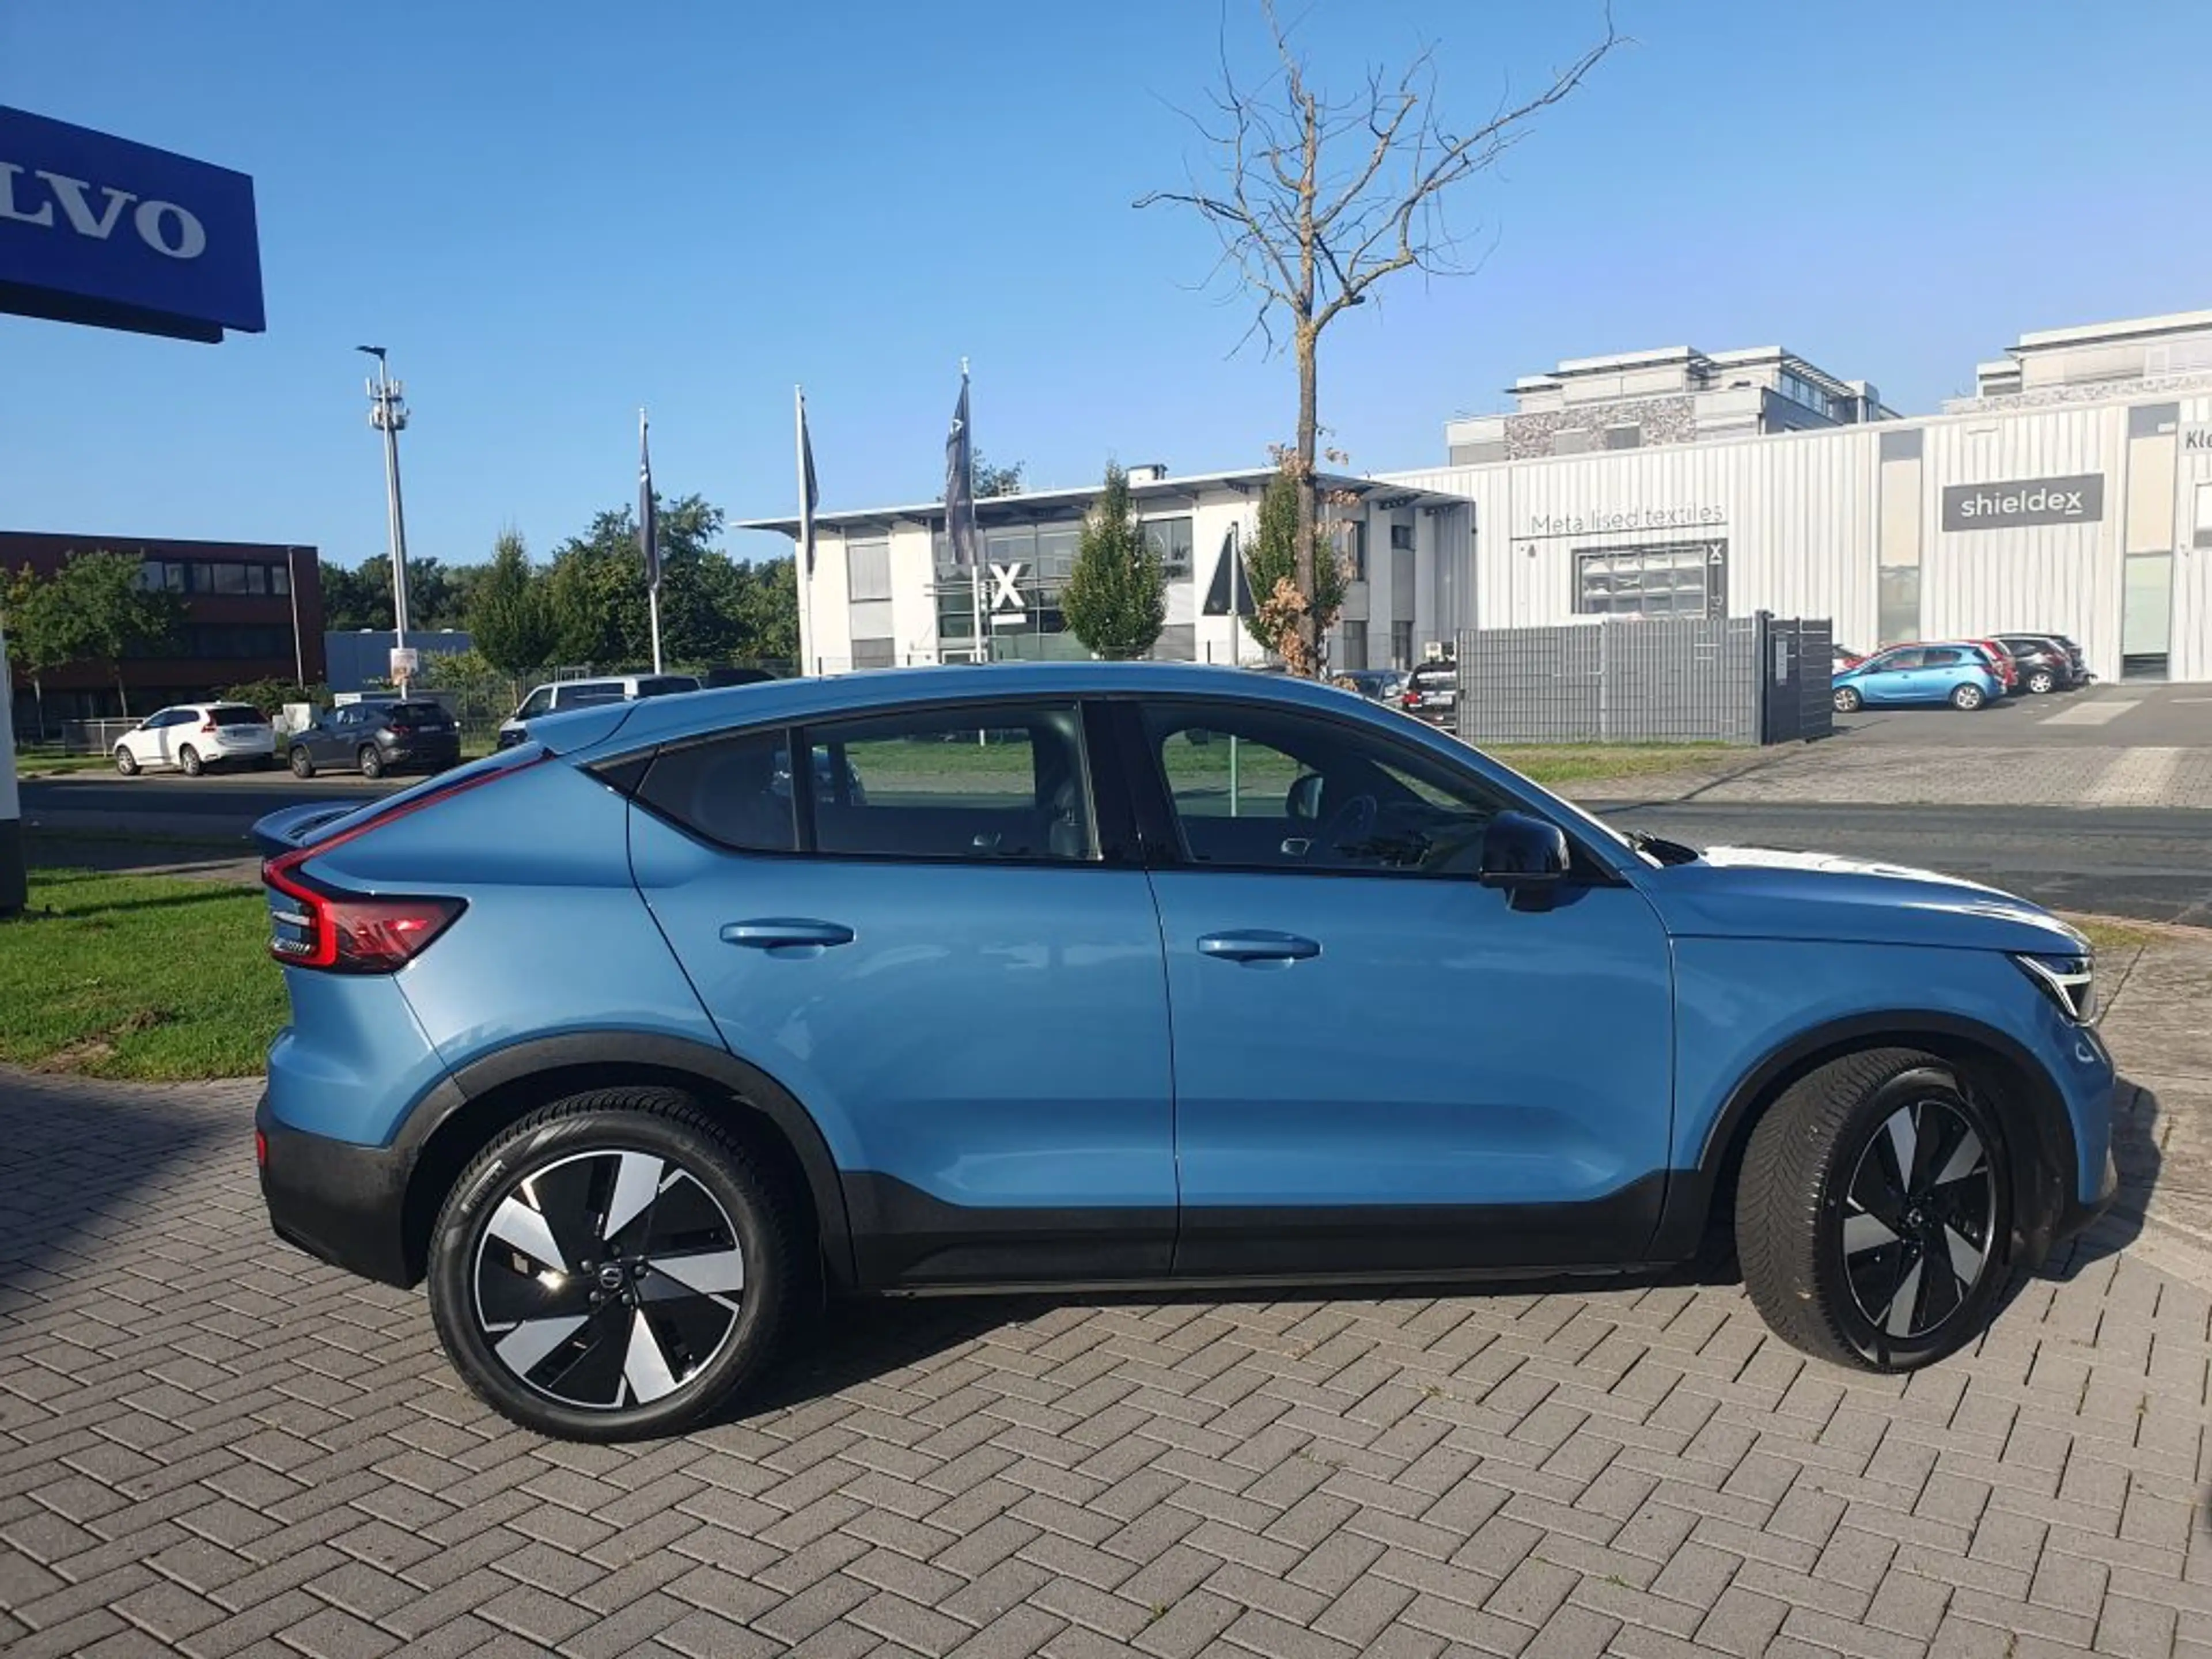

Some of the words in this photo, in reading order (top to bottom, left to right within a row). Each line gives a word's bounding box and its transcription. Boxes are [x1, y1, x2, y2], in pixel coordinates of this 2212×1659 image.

[0, 161, 206, 259] LVO
[1645, 501, 1722, 526] textiles
[1961, 488, 2083, 517] shieldex
